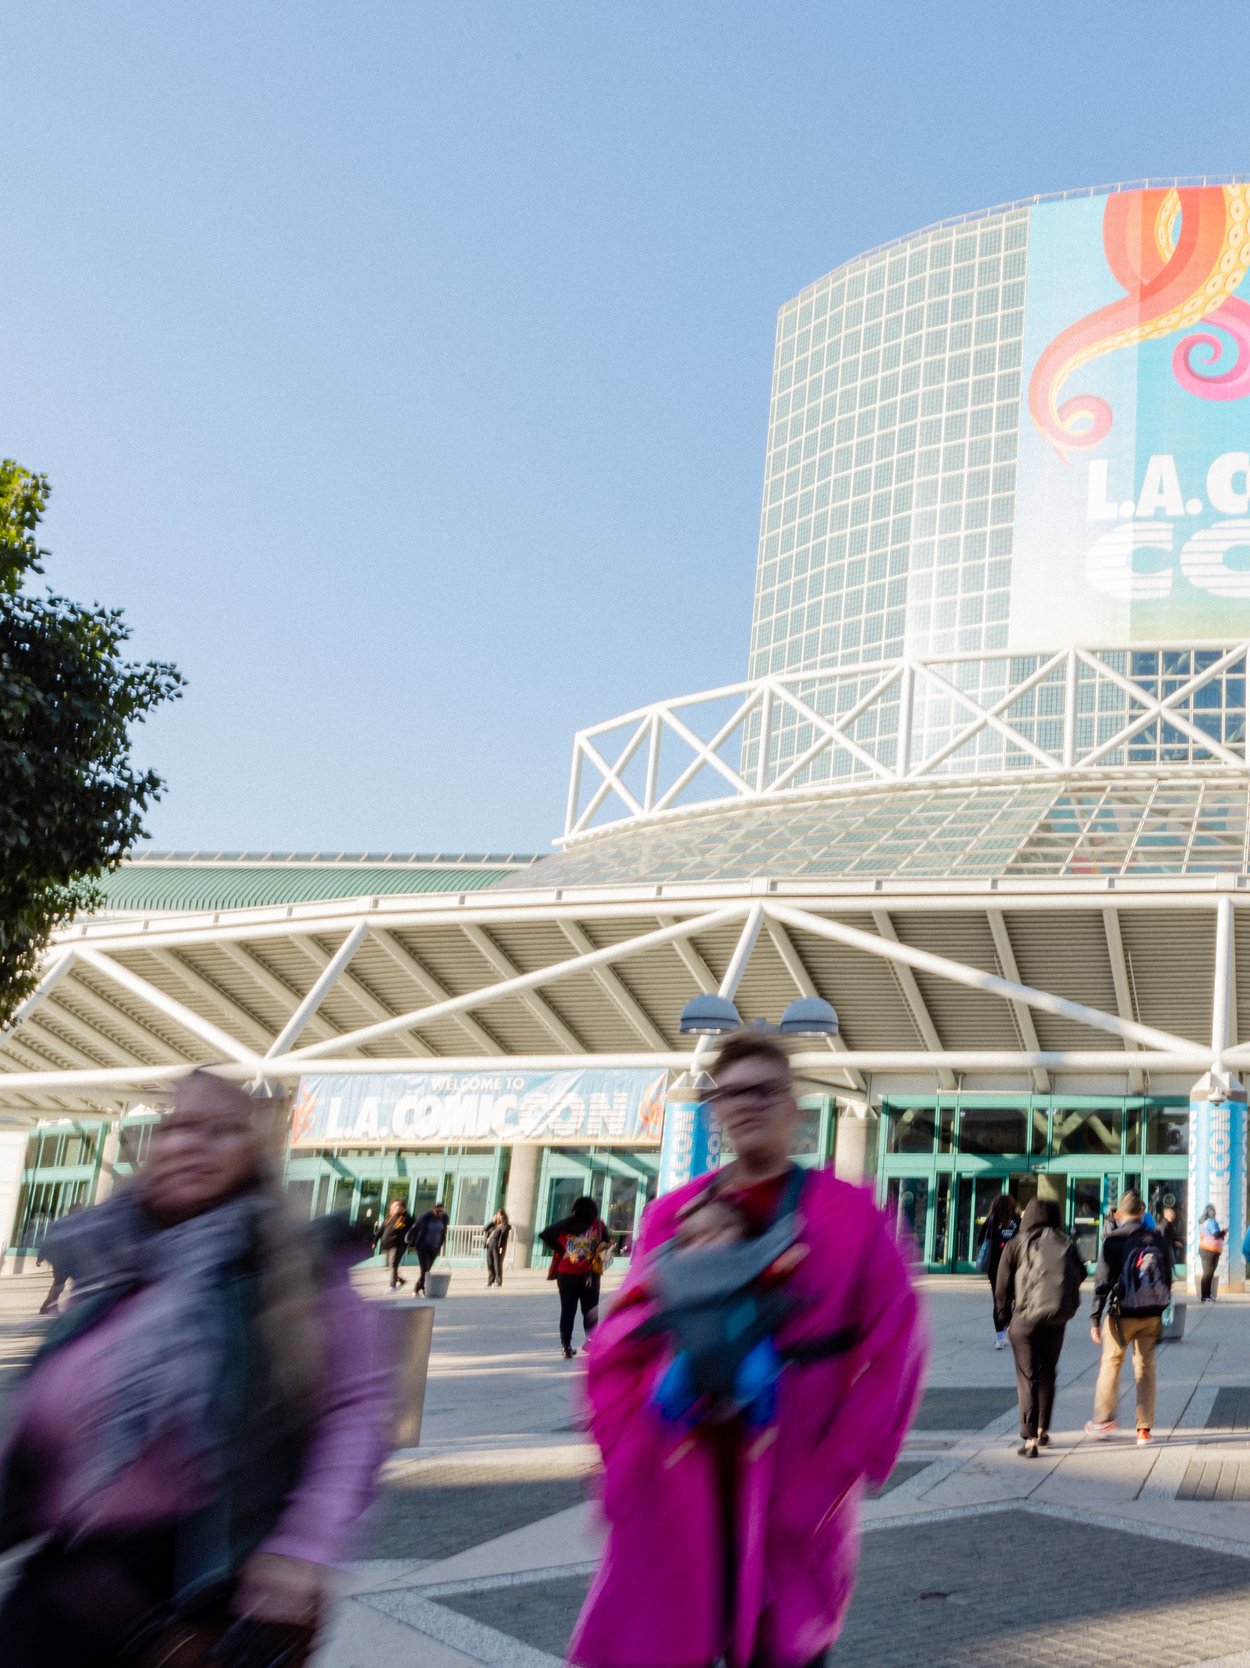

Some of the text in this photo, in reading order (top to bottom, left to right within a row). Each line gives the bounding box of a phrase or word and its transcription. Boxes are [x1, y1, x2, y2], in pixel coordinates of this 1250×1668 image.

[431, 1076, 524, 1091] WELCOME TO
[518, 1091, 628, 1138] CON
[671, 1111, 695, 1171] CON
[1209, 1110, 1230, 1171] CON
